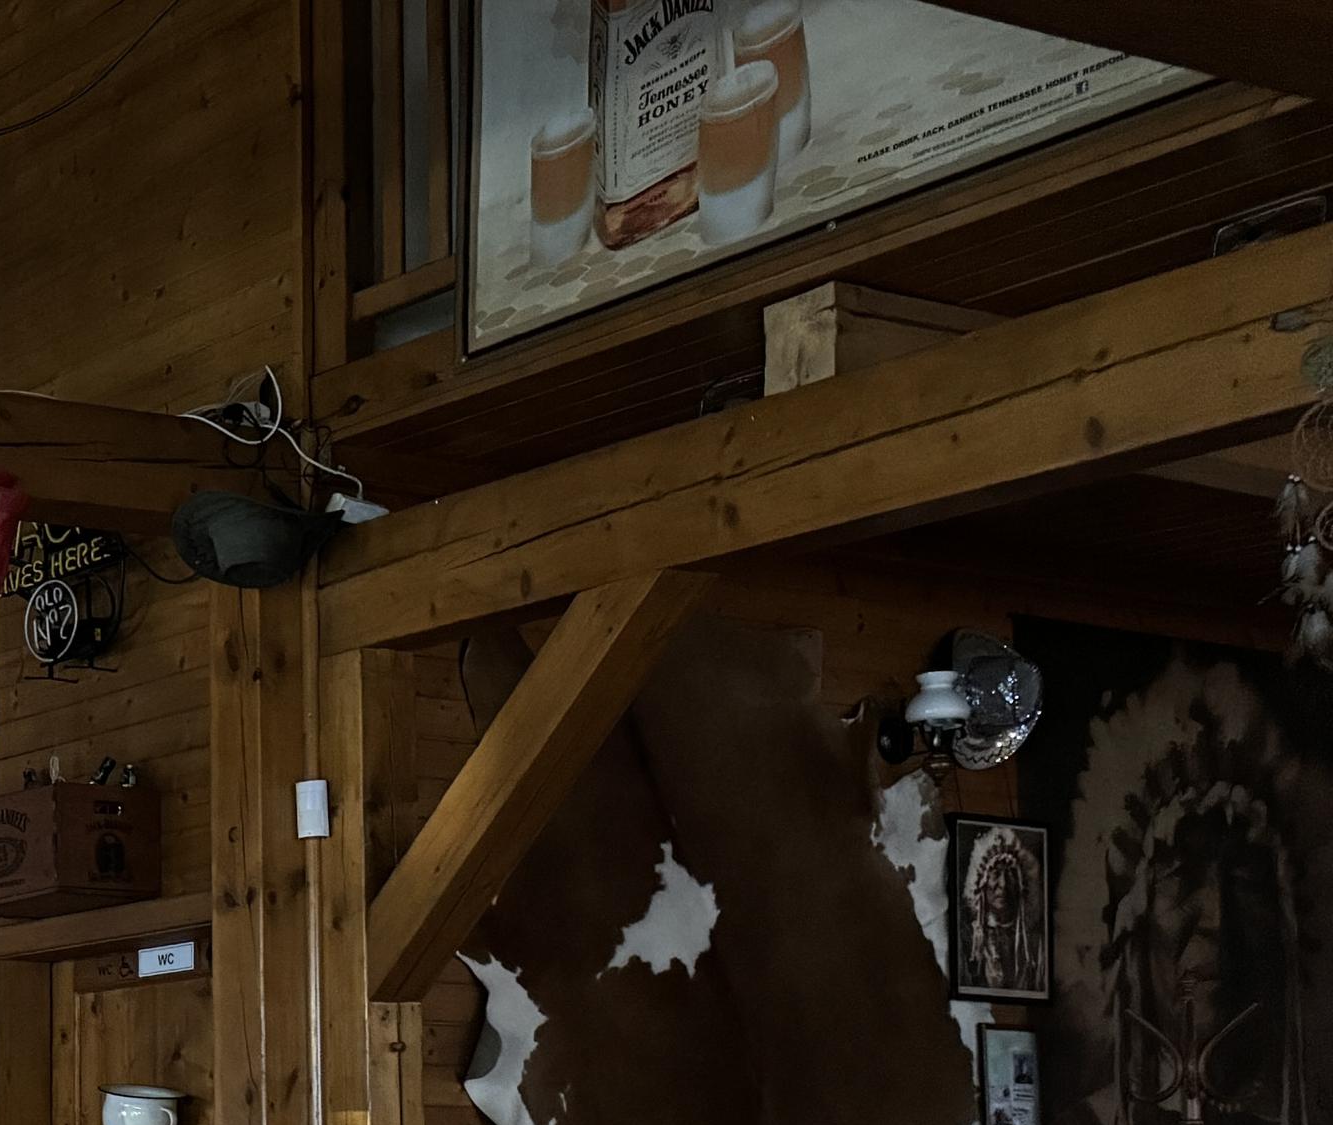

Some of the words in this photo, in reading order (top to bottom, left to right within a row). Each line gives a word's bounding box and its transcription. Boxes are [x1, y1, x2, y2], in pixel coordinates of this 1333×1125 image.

[623, 10, 663, 65] JACK
[638, 64, 709, 110] Tennessee
[1045, 71, 1080, 90] HONEY
[638, 79, 710, 129] HONEY
[157, 952, 174, 966] WC
